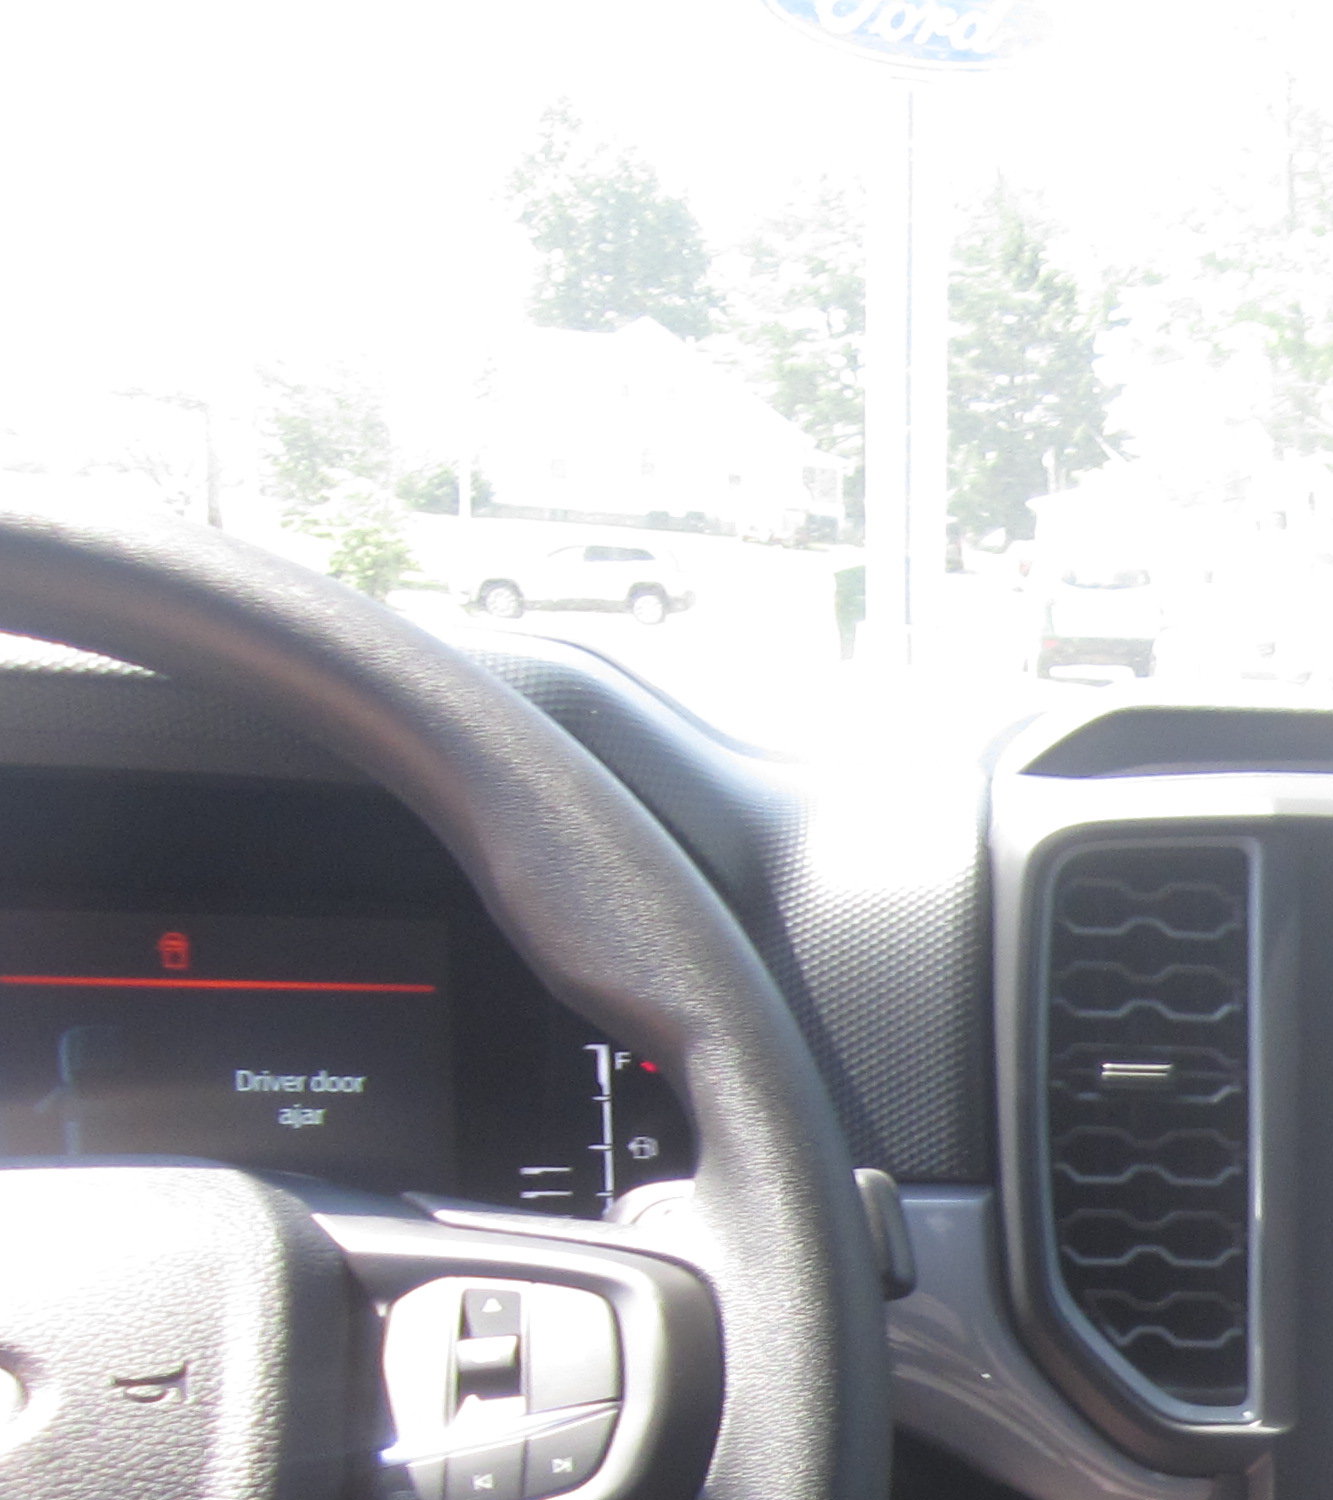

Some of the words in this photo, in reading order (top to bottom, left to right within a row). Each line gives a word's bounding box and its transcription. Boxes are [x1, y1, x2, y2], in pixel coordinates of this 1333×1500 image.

[614, 1051, 632, 1070] F
[235, 1069, 307, 1092] Driver
[310, 1069, 367, 1093] door
[278, 1103, 327, 1130] ajar
